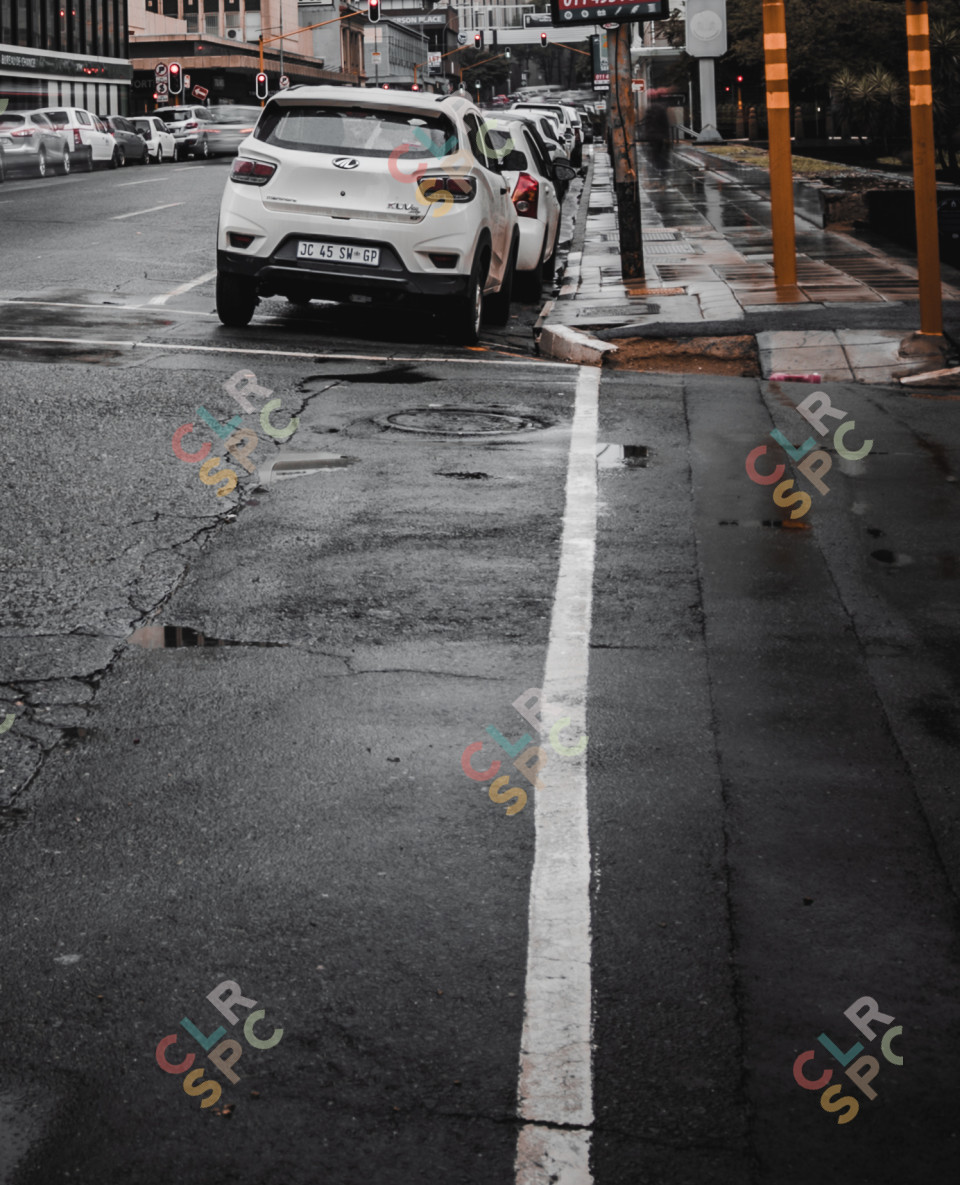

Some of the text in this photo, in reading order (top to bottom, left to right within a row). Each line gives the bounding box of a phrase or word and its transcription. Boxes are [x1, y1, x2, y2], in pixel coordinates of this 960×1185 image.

[300, 243, 378, 262] JC 45 SW GP
